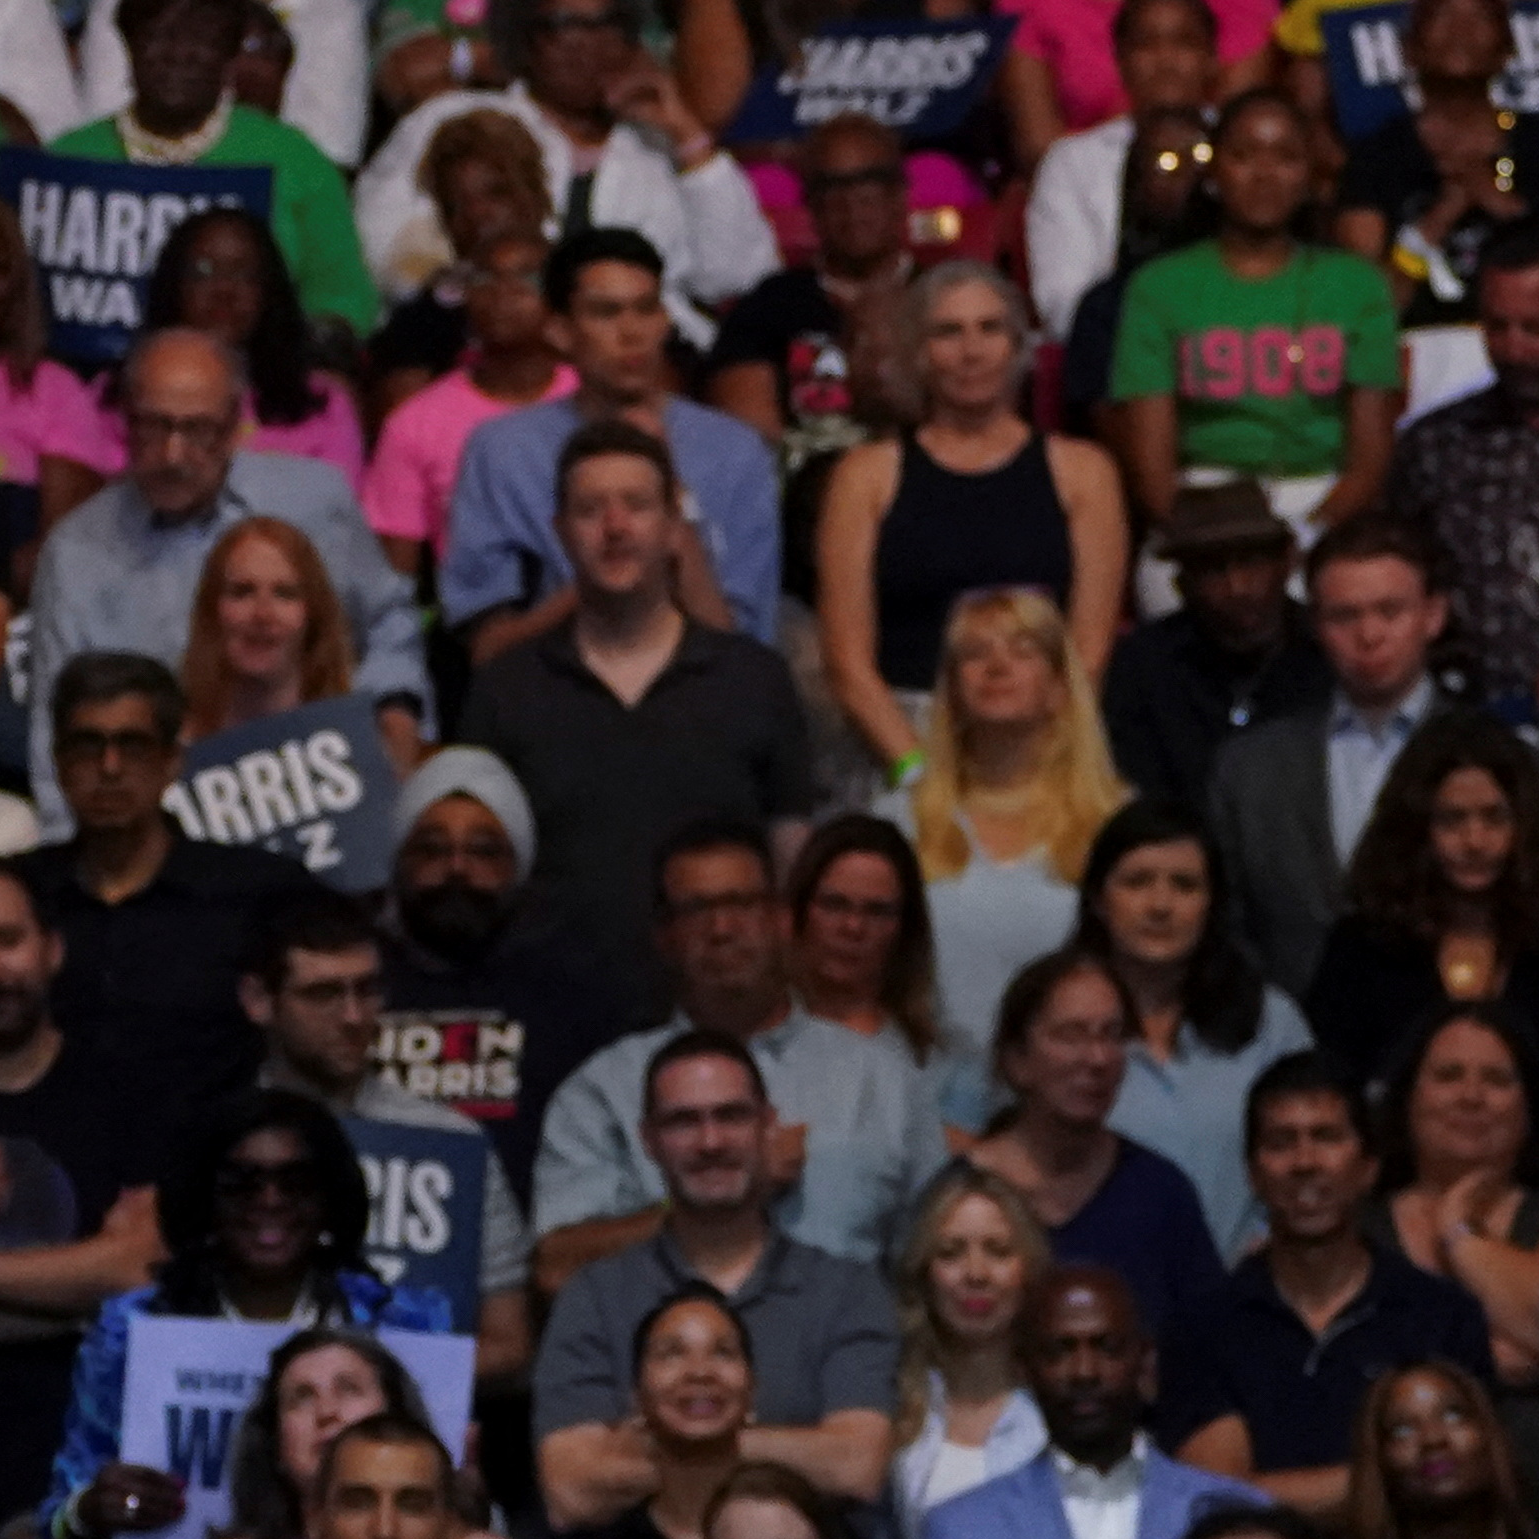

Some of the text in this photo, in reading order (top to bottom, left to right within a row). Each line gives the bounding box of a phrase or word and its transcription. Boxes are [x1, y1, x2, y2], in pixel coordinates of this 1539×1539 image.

[49, 273, 145, 330] WA
[1178, 322, 1347, 396] 1908
[161, 730, 362, 846] ARRIS
